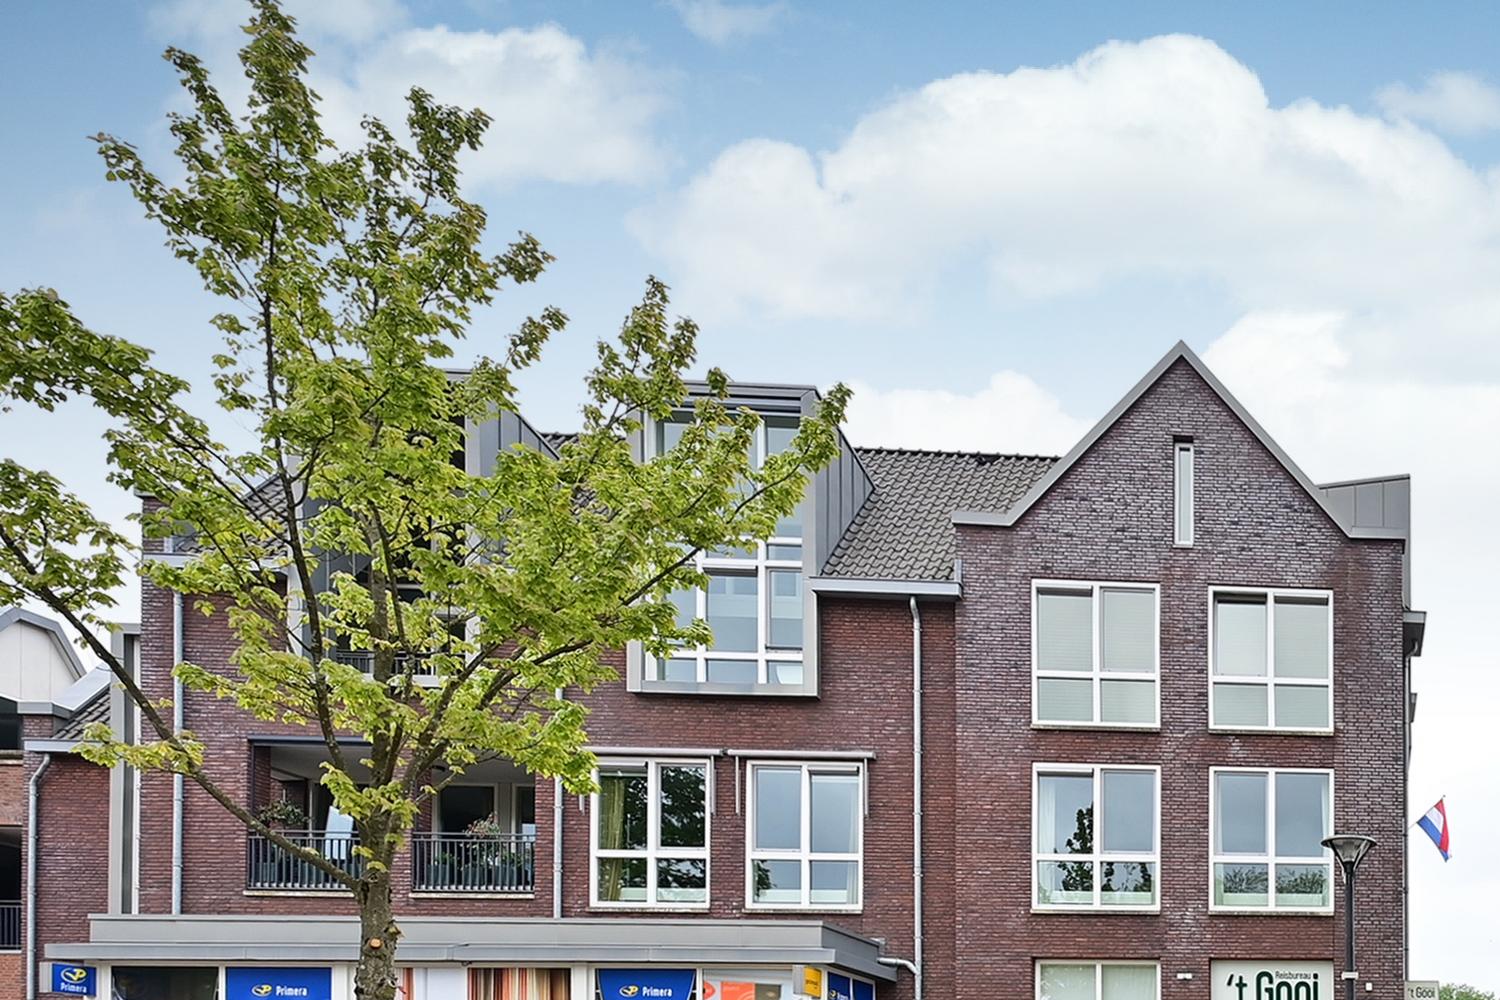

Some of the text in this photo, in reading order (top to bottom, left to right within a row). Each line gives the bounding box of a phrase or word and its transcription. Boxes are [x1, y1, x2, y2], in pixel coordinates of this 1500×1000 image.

[1275, 971, 1312, 980] Reisbureau
[60, 982, 88, 994] Primera
[275, 985, 308, 997] Primera
[642, 985, 673, 998] Primera
[1415, 986, 1436, 999] Gooi
